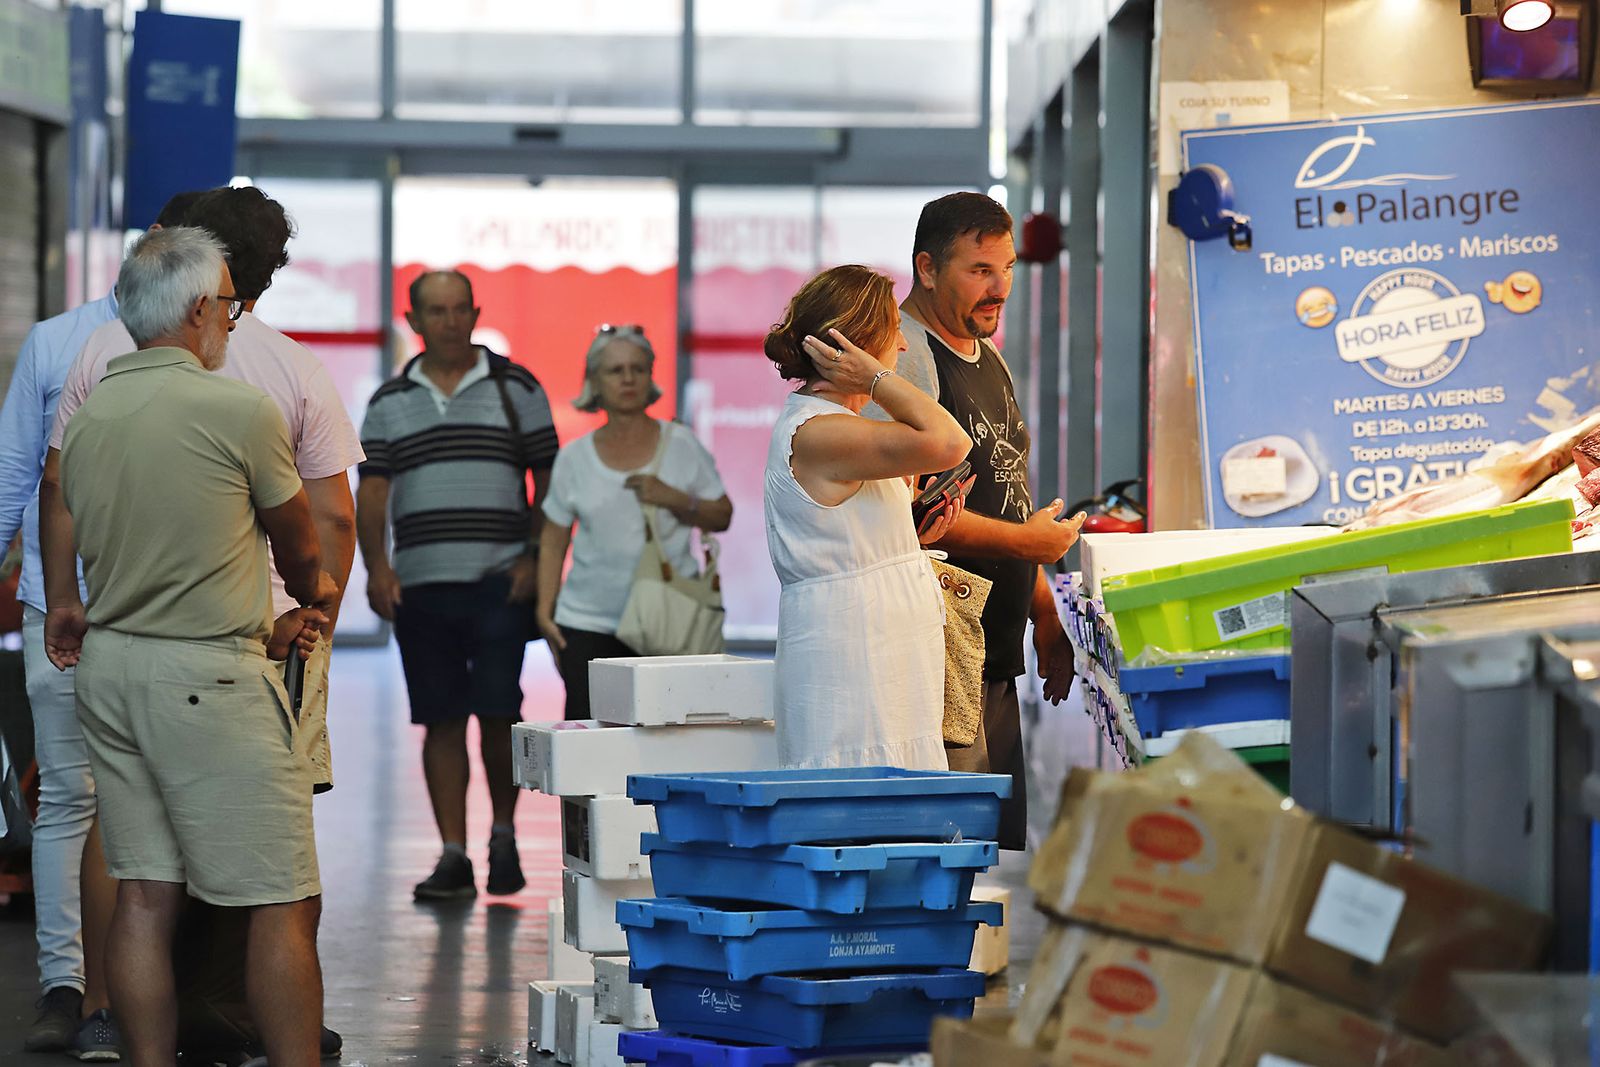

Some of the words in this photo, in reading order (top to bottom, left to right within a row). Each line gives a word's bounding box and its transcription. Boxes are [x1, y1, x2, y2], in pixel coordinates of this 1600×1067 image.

[1229, 95, 1271, 107] TURNO
[1295, 195, 1324, 230] El
[1356, 188, 1520, 225] Palangre
[1259, 251, 1326, 278] Tapas
[1340, 240, 1444, 269] Pescados
[1459, 233, 1559, 259] Mariscos
[1343, 321, 1412, 348] HORA
[1415, 306, 1477, 334] FELIZ
[1333, 393, 1410, 416] MARTES
[1411, 393, 1427, 409] A
[1427, 386, 1506, 408] VIERNES
[1353, 420, 1378, 438] DE
[1350, 445, 1392, 464] Tapa
[829, 945, 853, 957] LONJA
[855, 943, 896, 956] AYAMONTE
